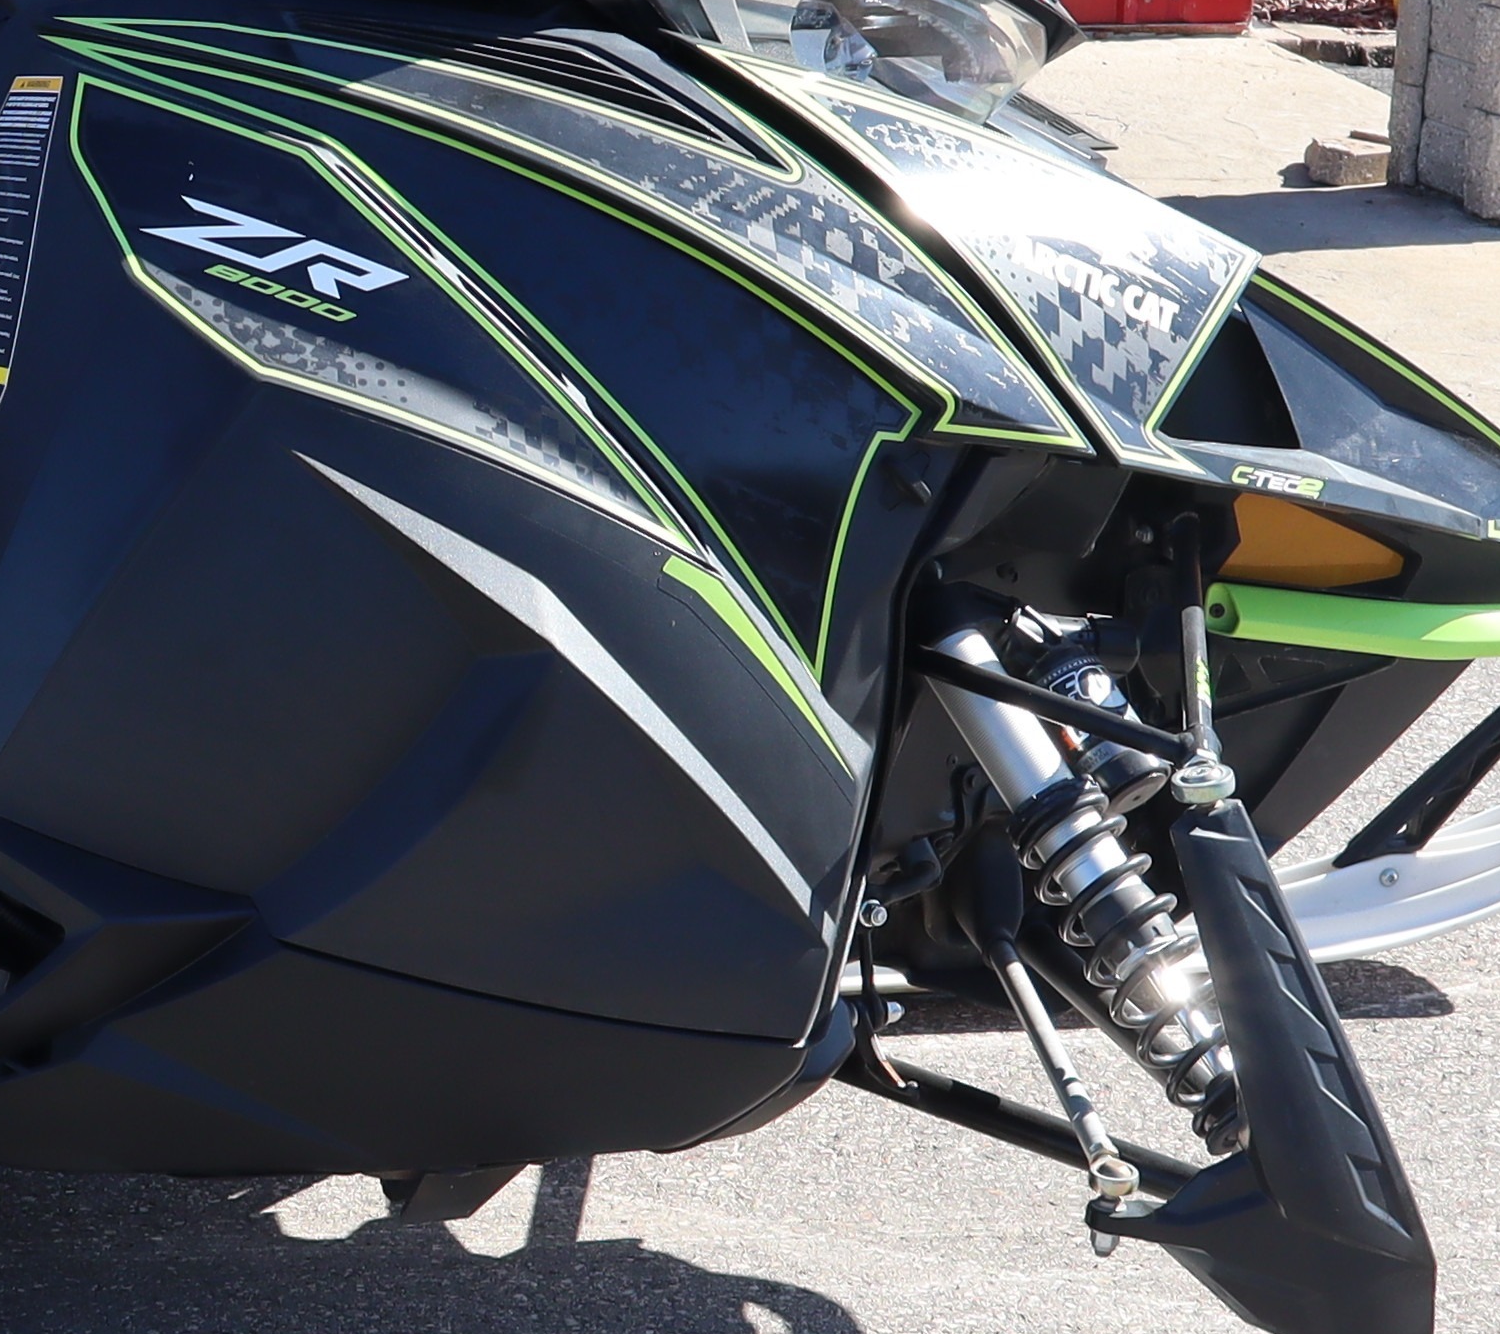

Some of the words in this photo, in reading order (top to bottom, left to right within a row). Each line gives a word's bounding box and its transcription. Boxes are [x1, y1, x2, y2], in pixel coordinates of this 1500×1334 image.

[139, 194, 410, 300] ZR
[203, 264, 358, 322] 8000
[1012, 240, 1120, 309] ARCTIC
[1122, 284, 1181, 334] CAT
[1231, 465, 1325, 500] C-TEC2
